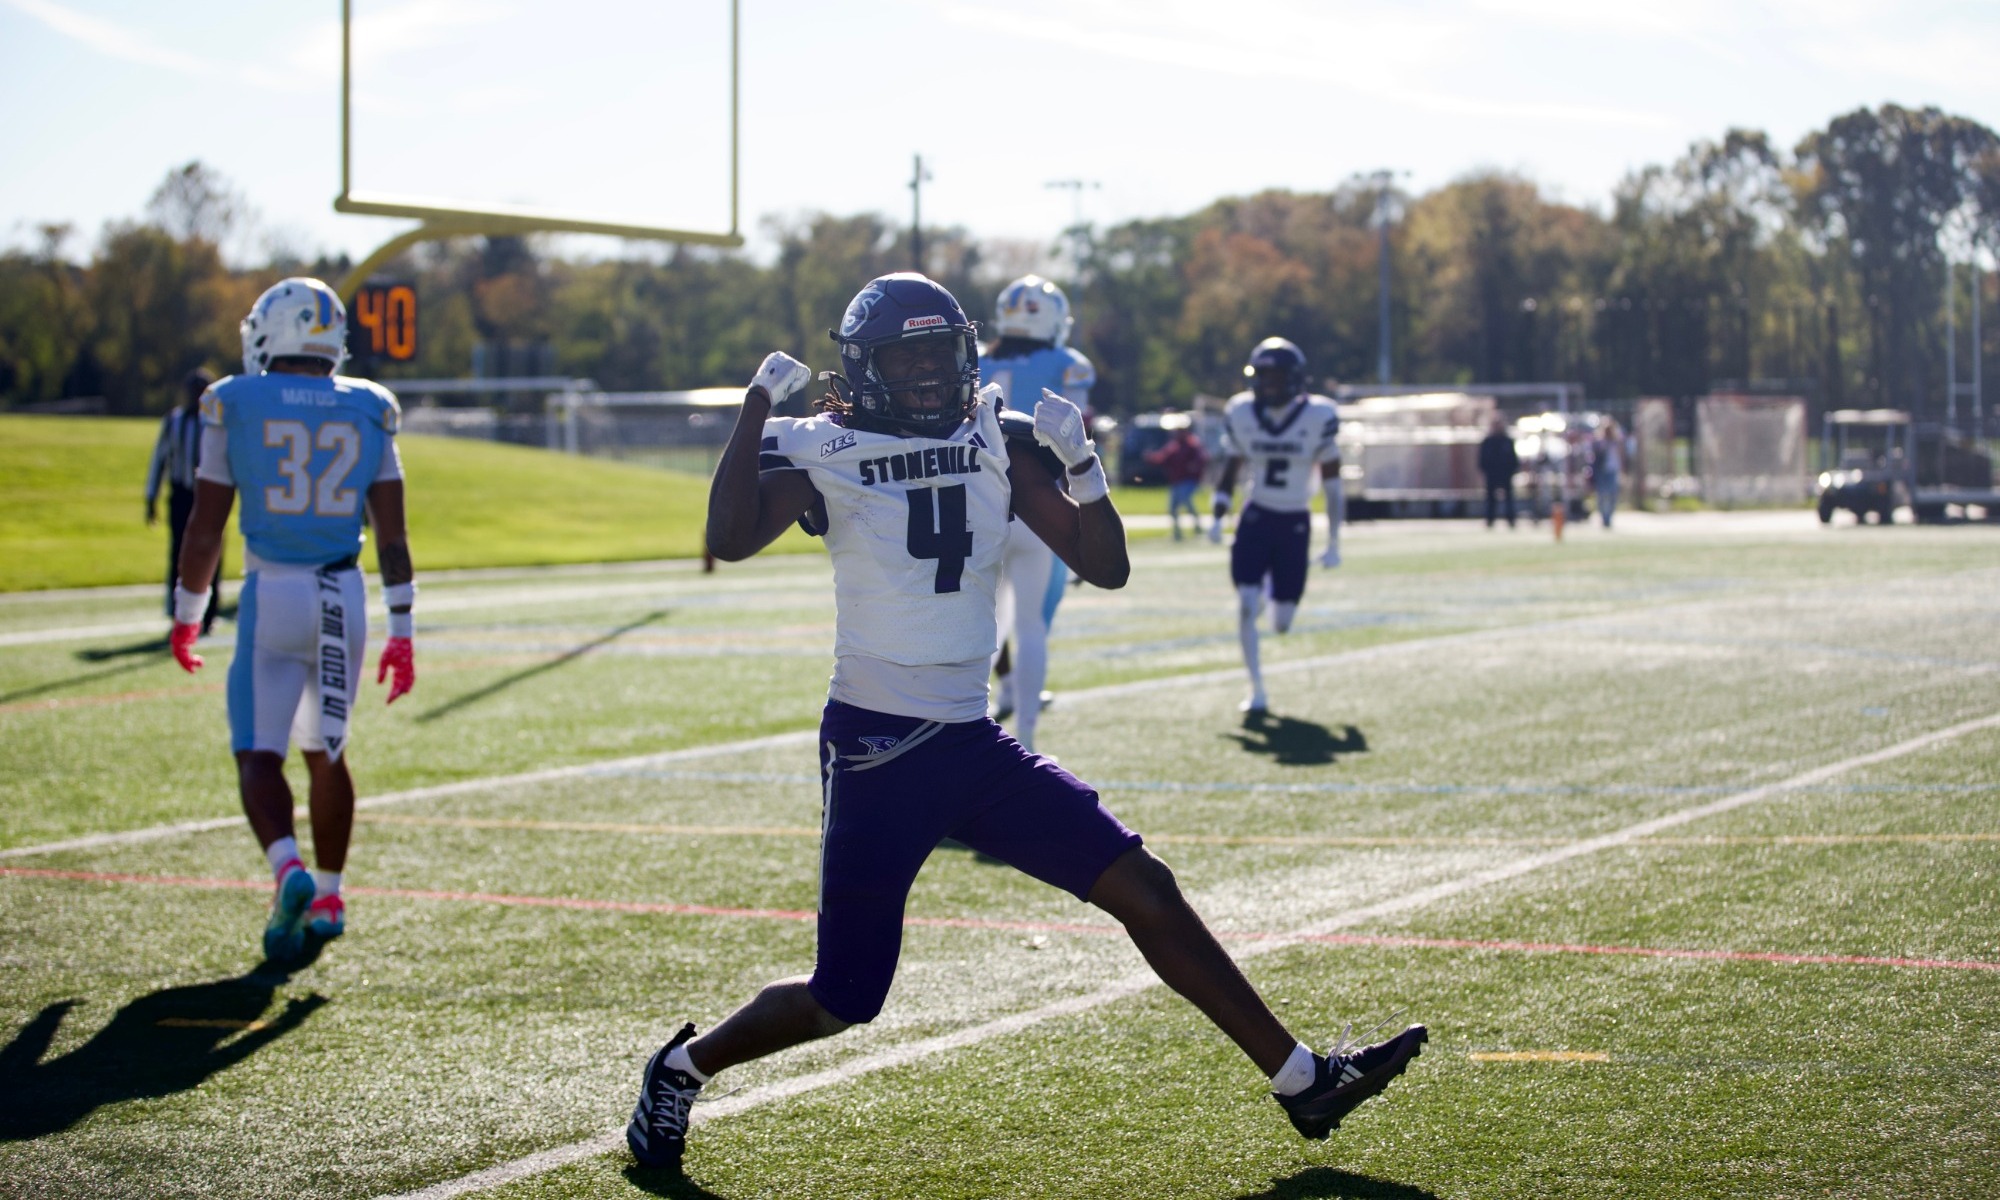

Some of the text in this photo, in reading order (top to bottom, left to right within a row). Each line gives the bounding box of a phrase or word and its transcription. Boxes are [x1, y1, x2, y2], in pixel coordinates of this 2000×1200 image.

[356, 286, 417, 360] 40
[908, 316, 943, 328] Riddell
[820, 431, 855, 458] NEC
[263, 418, 361, 517] 32
[1264, 457, 1290, 489] 2
[906, 483, 974, 594] 4
[321, 601, 345, 640] WE
[321, 645, 346, 692] GOD
[322, 694, 346, 722] IN
